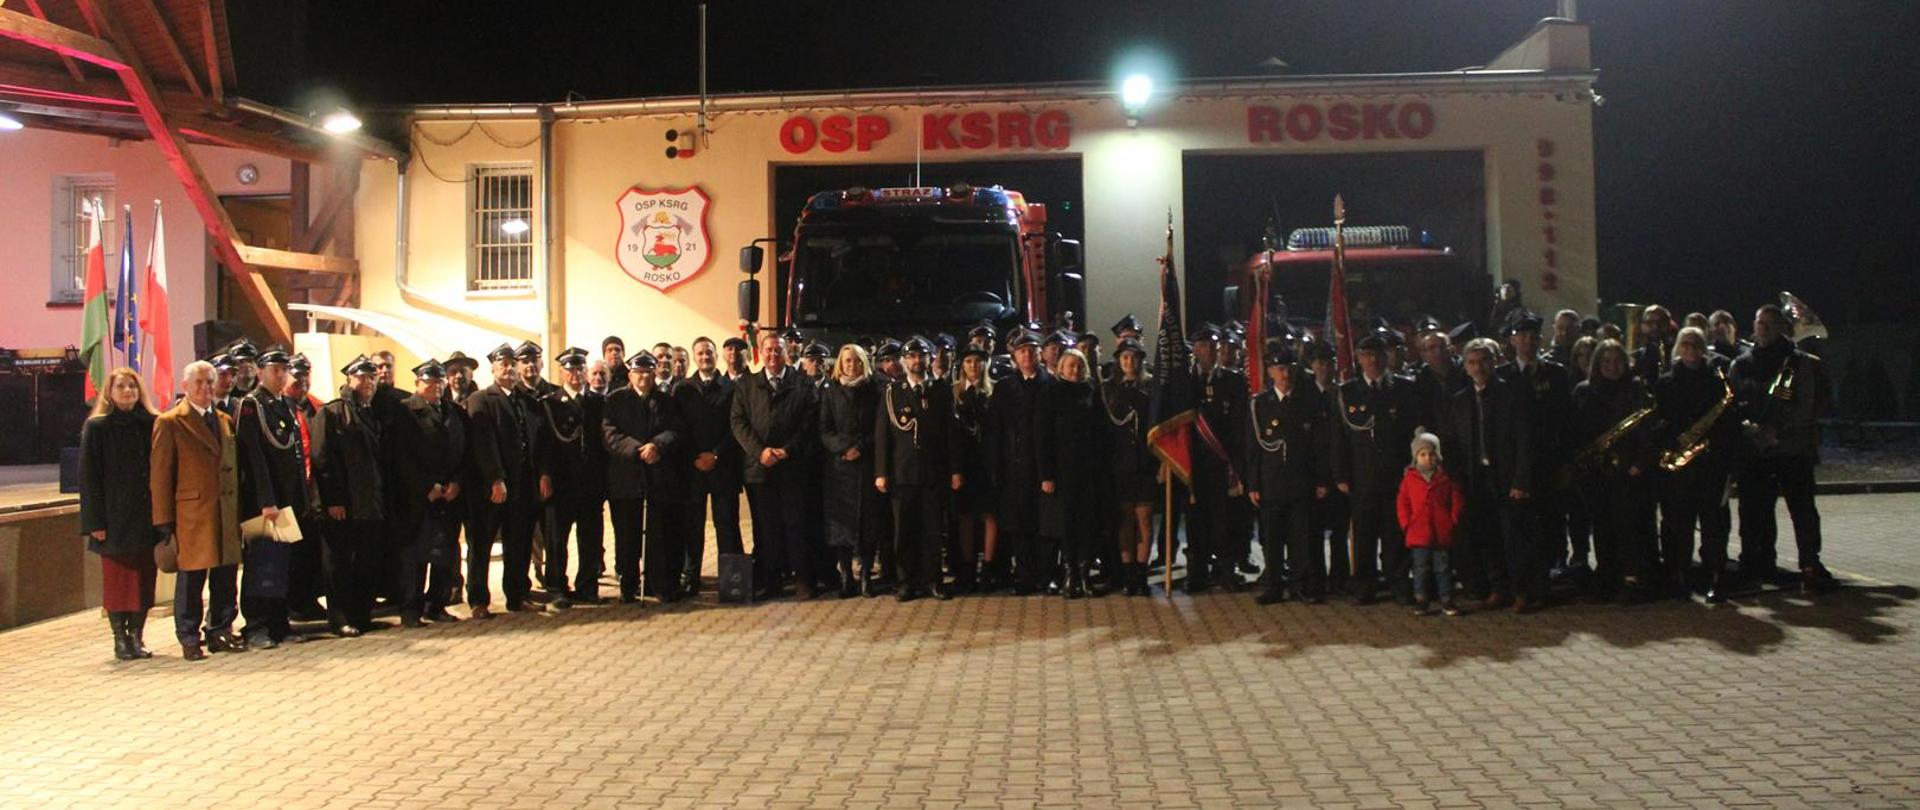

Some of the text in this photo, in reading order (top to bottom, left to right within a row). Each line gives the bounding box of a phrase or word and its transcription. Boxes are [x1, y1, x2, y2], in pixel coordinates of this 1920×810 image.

[1247, 102, 1435, 143] ROSKO
[779, 110, 1072, 154] OSP KSRG
[635, 199, 689, 212] OSP KSRG
[627, 243, 639, 252] 19
[685, 243, 697, 252] 21
[644, 271, 681, 283] ROSKO
